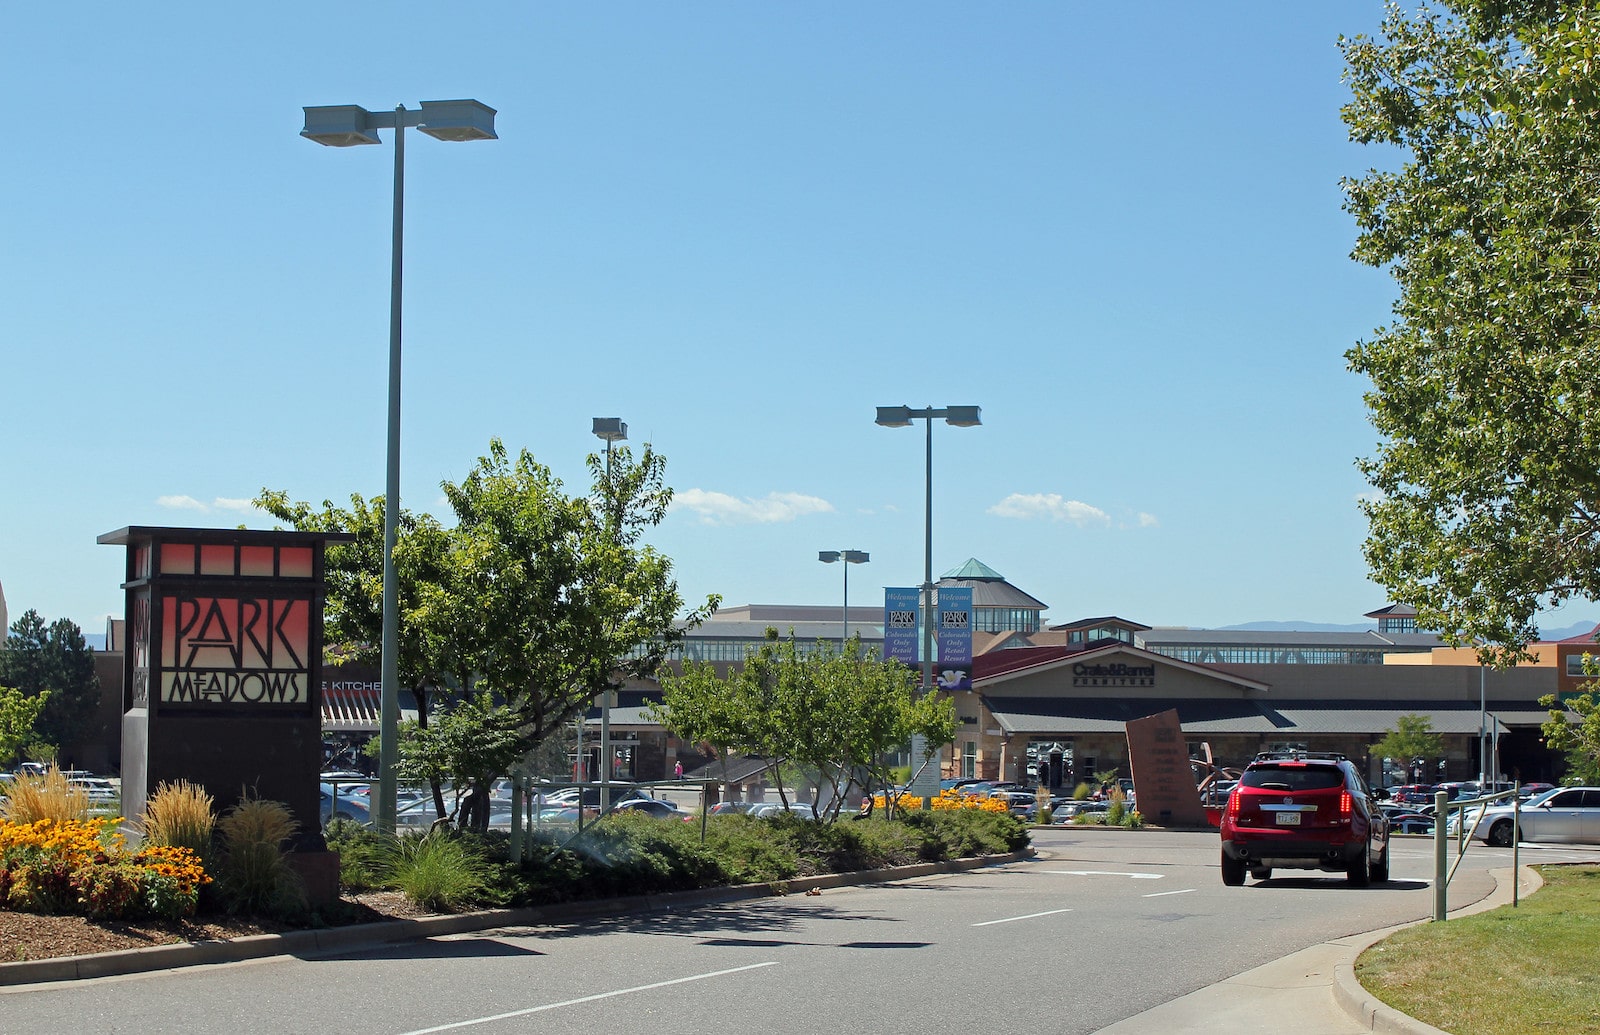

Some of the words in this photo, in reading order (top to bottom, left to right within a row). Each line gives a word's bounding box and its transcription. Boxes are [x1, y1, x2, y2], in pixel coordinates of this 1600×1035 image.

[890, 611, 914, 624] PARK
[943, 611, 967, 624] PARK
[176, 598, 306, 669] PARK
[893, 639, 910, 647] Only
[946, 639, 964, 647] Only
[1074, 663, 1154, 676] Crate&Barrel
[170, 672, 298, 702] MEADOWS
[332, 682, 382, 690] KITCHE
